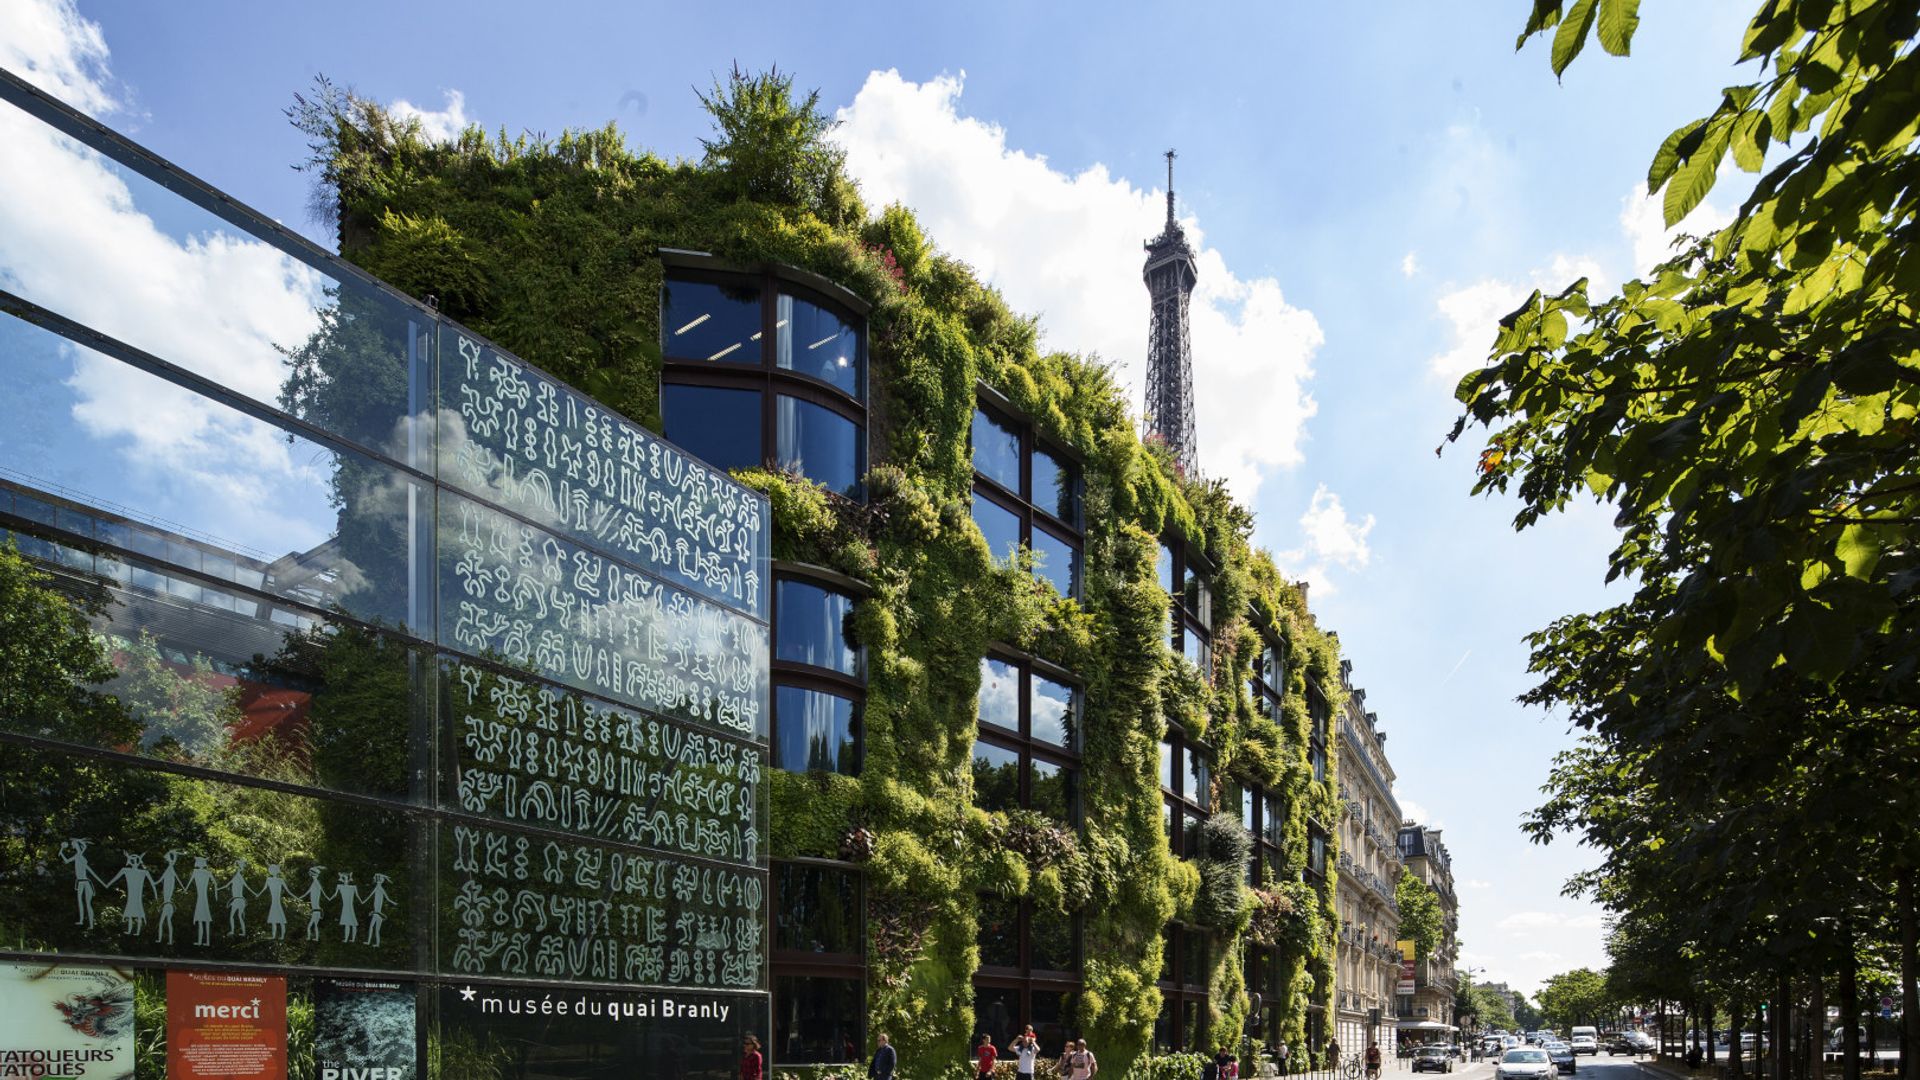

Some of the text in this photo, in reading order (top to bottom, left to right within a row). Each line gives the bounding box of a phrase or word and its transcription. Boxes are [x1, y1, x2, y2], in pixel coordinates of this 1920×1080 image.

[195, 997, 261, 1019] merci
[481, 994, 729, 1022] musée du quai Branly
[322, 1059, 340, 1069] the
[322, 1067, 402, 1080] RIVER
